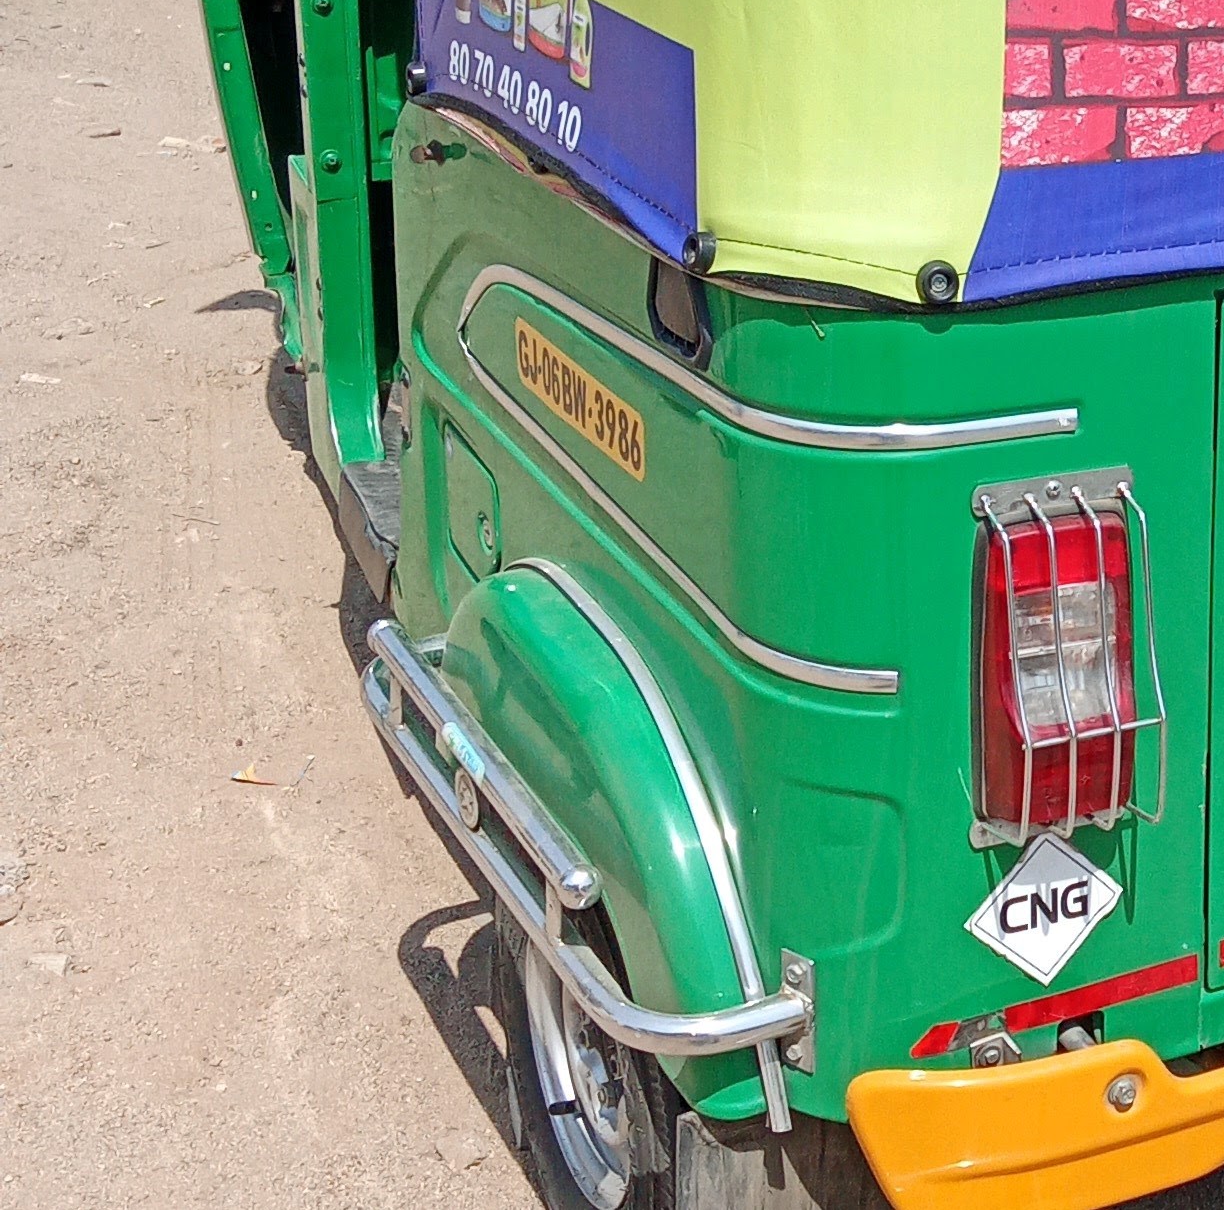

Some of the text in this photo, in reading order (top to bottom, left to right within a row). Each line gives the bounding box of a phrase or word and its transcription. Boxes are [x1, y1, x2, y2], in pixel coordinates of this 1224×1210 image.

[449, 40, 581, 152] 80 70 40 80 10
[1000, 880, 1089, 934] CNG
